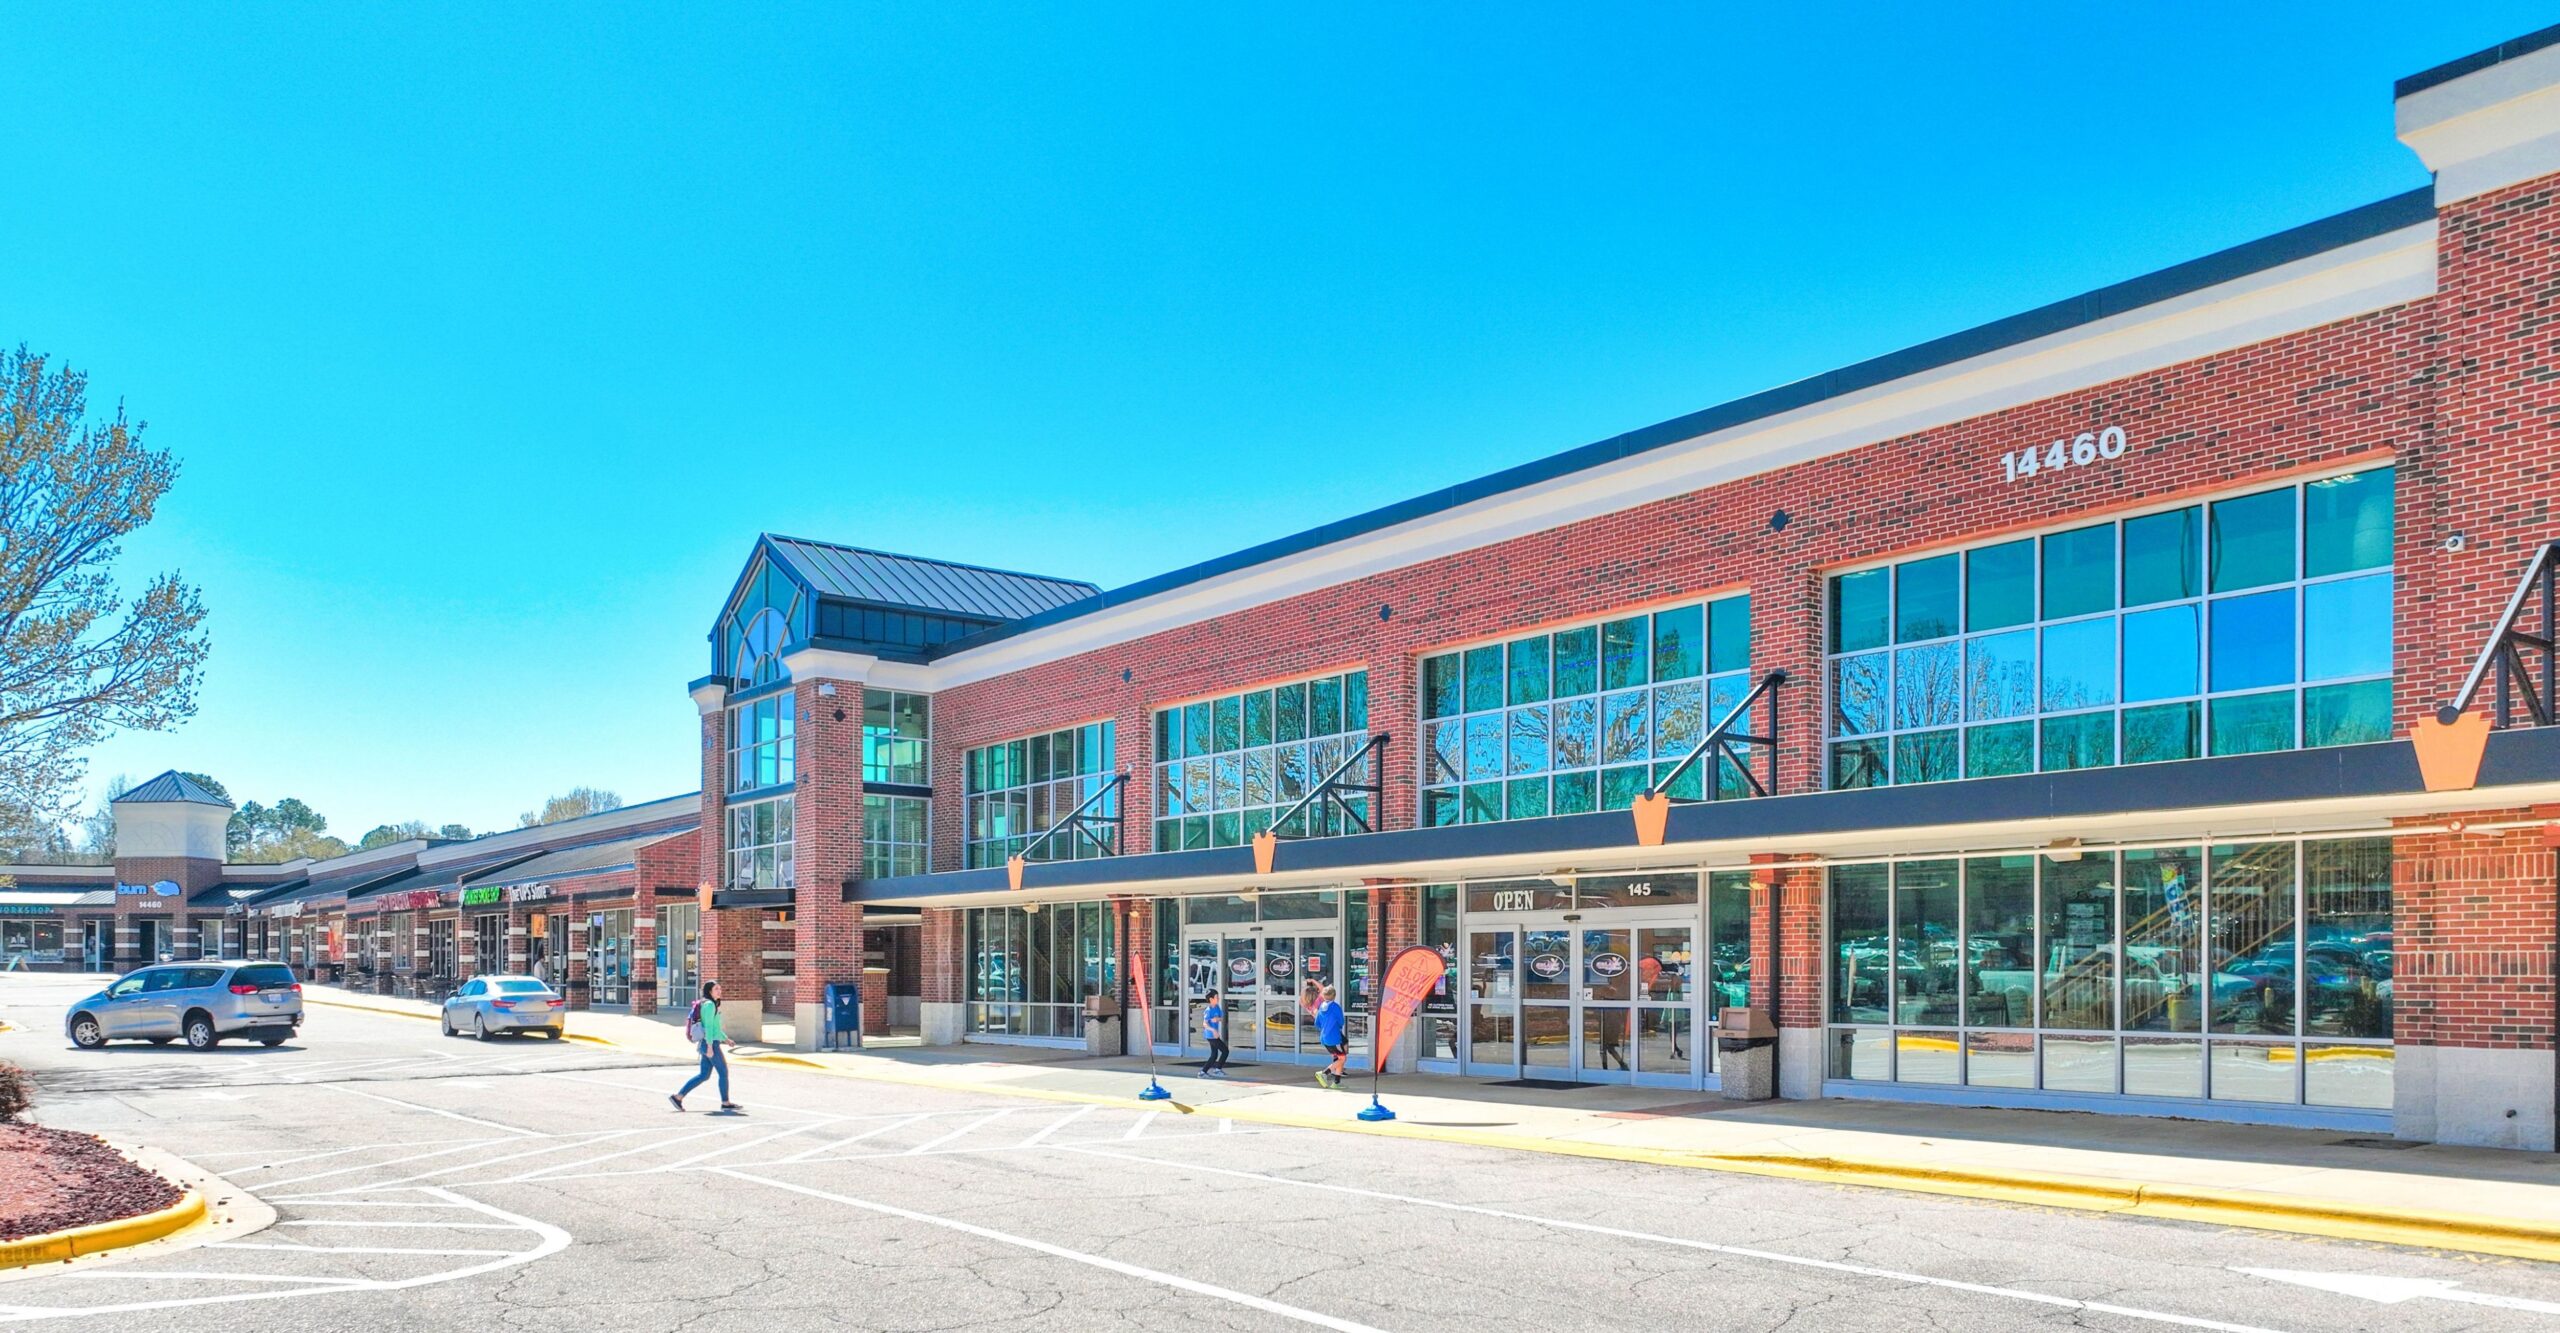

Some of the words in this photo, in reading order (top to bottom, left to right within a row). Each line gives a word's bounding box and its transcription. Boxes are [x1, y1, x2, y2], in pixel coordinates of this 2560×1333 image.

[2001, 426, 2126, 483] 14460
[1627, 882, 1652, 896] 145
[1493, 889, 1535, 911] OPEN
[1400, 966, 1430, 985] SLOW
[1392, 976, 1425, 995] DOWN
